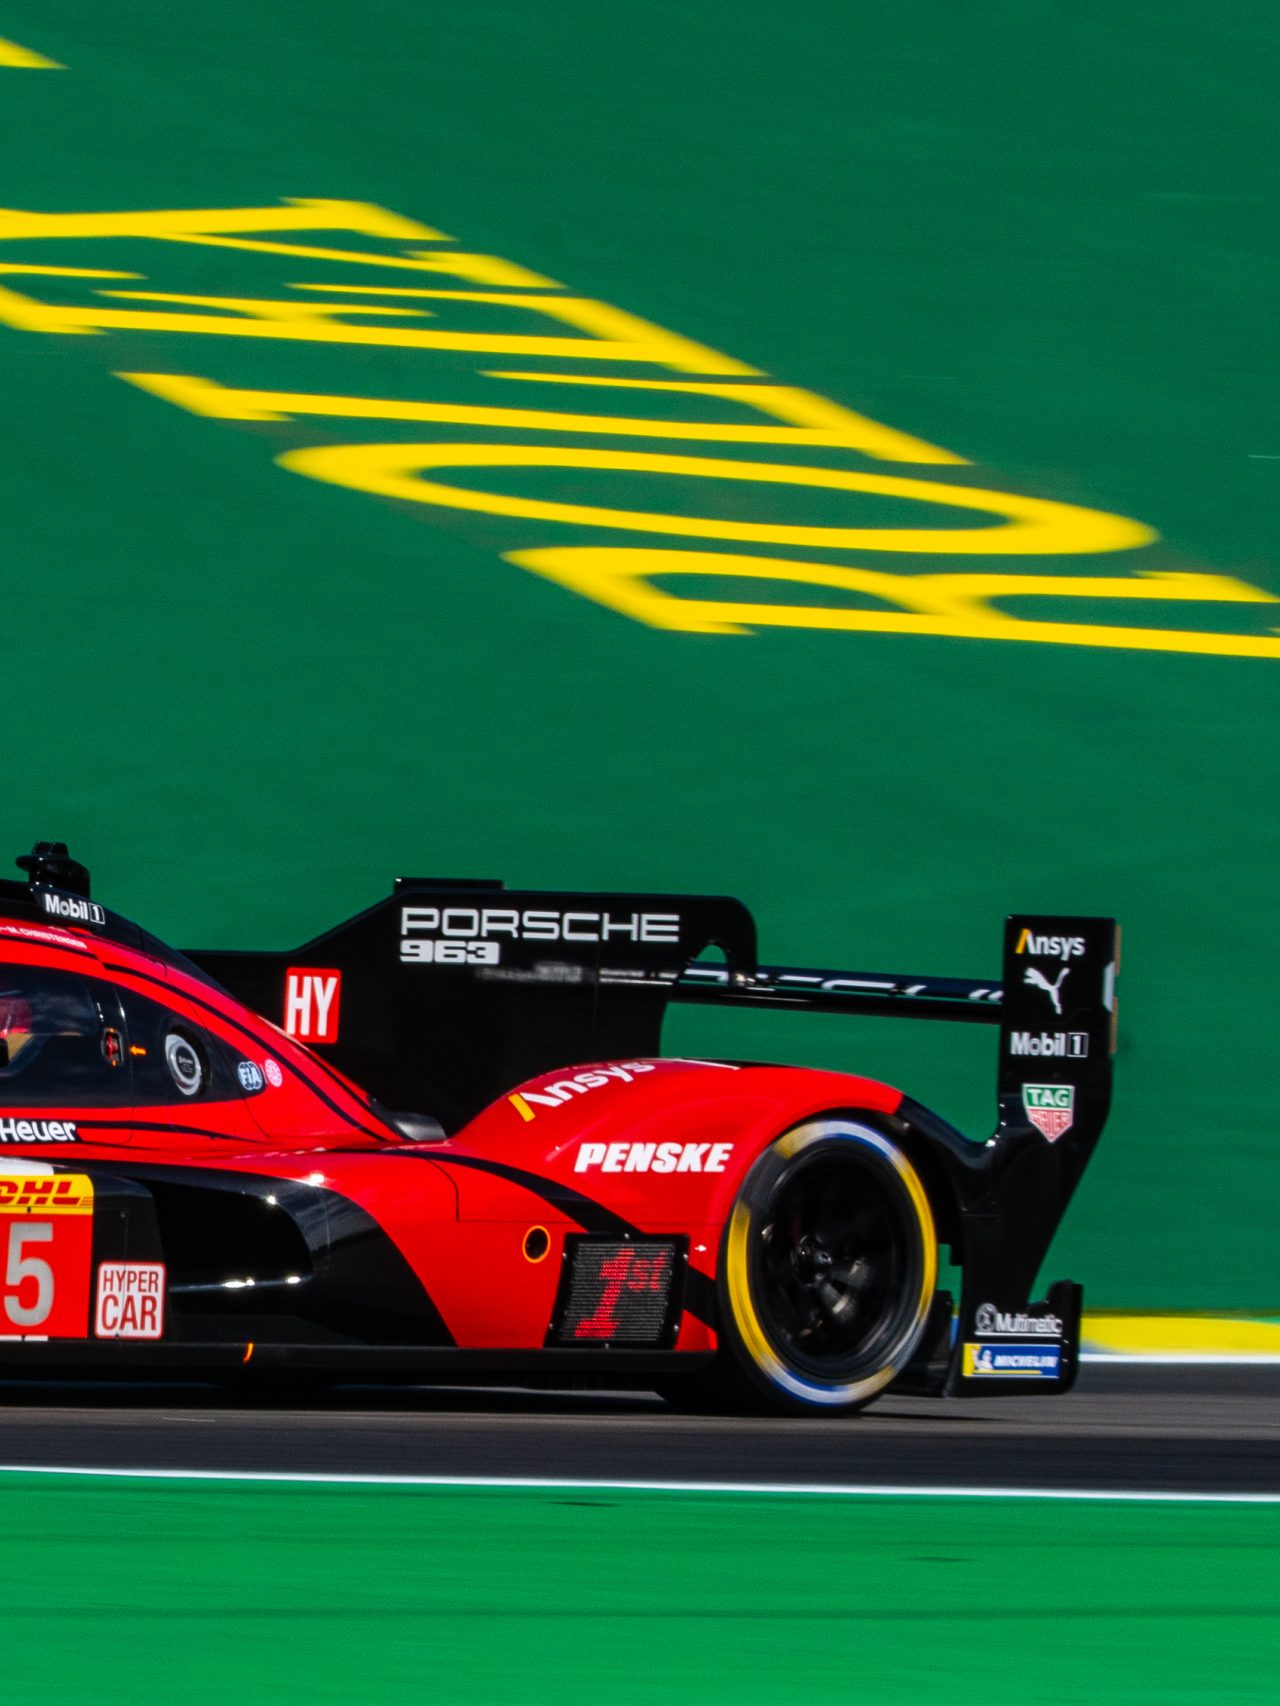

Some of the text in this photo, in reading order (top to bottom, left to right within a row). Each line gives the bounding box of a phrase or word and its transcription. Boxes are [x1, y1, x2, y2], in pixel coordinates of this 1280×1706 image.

[44, 893, 103, 923] Mobil 1
[400, 906, 680, 943] PORSCHE
[399, 939, 500, 965] 963
[1015, 928, 1086, 961] Ansys
[286, 975, 338, 1036] HY
[1010, 1031, 1085, 1057] Mobil 1
[508, 1061, 656, 1122] Ansys
[1026, 1089, 1069, 1106] TAG
[574, 1143, 734, 1173] PENSKE
[3, 1222, 55, 1327] 5
[103, 1270, 159, 1293] HYPER
[101, 1294, 158, 1331] CAR
[994, 1312, 1063, 1333] Multimatic
